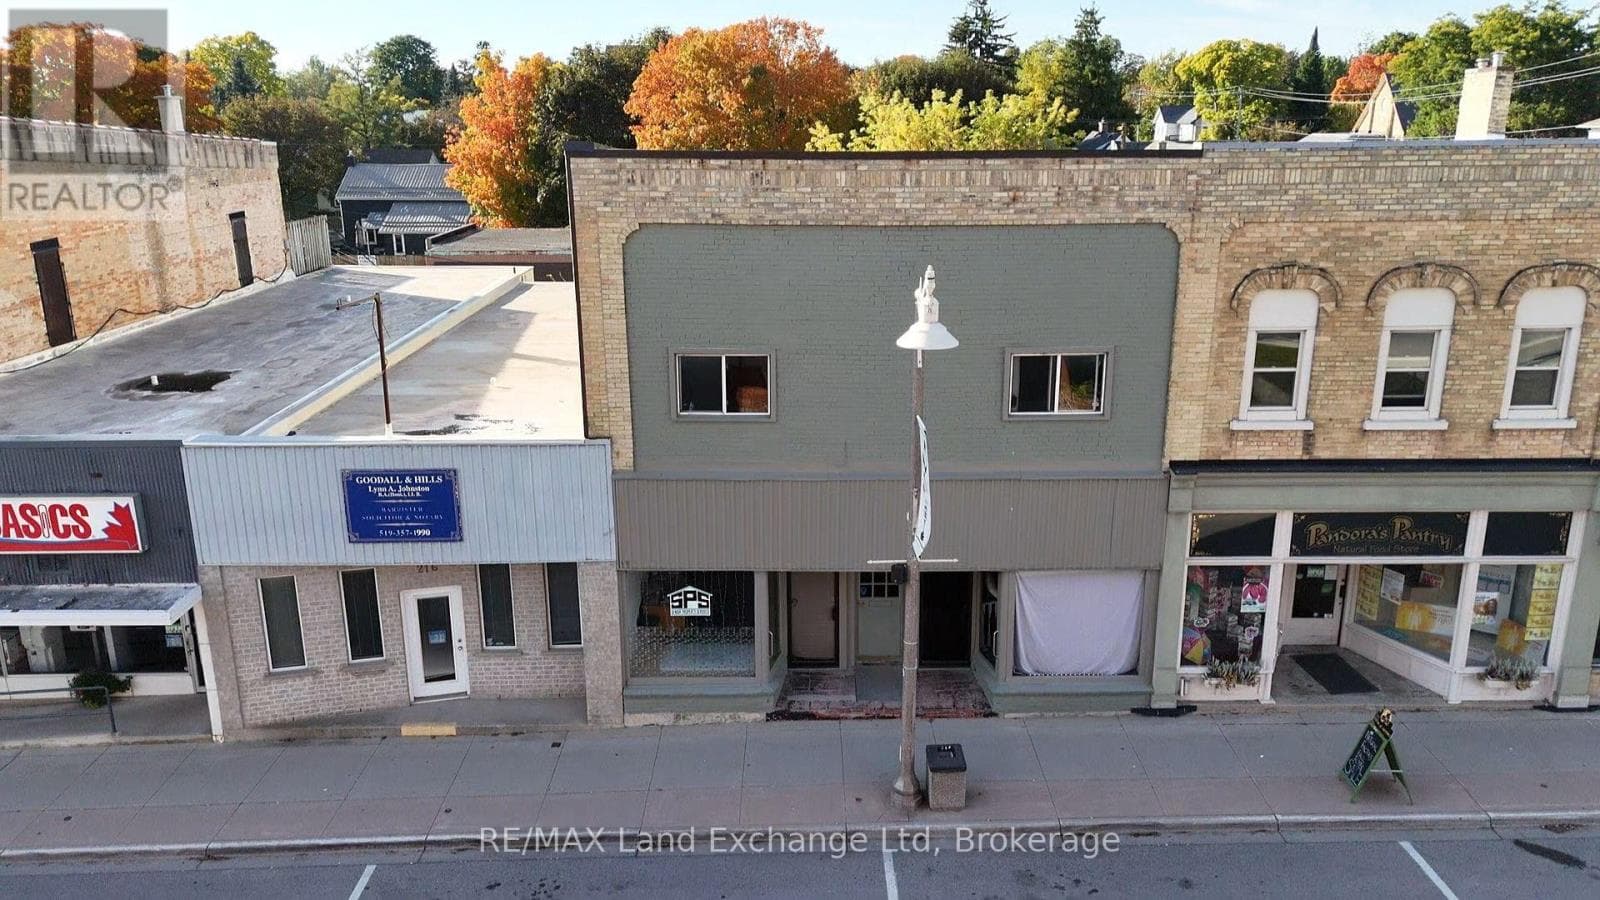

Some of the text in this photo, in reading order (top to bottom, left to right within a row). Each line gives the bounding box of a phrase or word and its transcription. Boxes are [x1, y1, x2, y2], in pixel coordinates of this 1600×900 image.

[355, 475, 443, 485] GOODALL & HILLS
[367, 485, 430, 494] Lynn A. Johnston
[0, 503, 92, 539] ASICS
[379, 528, 431, 537] 519-357-1990
[1305, 515, 1451, 551] Pandora's Pantry
[671, 591, 710, 608] SPS
